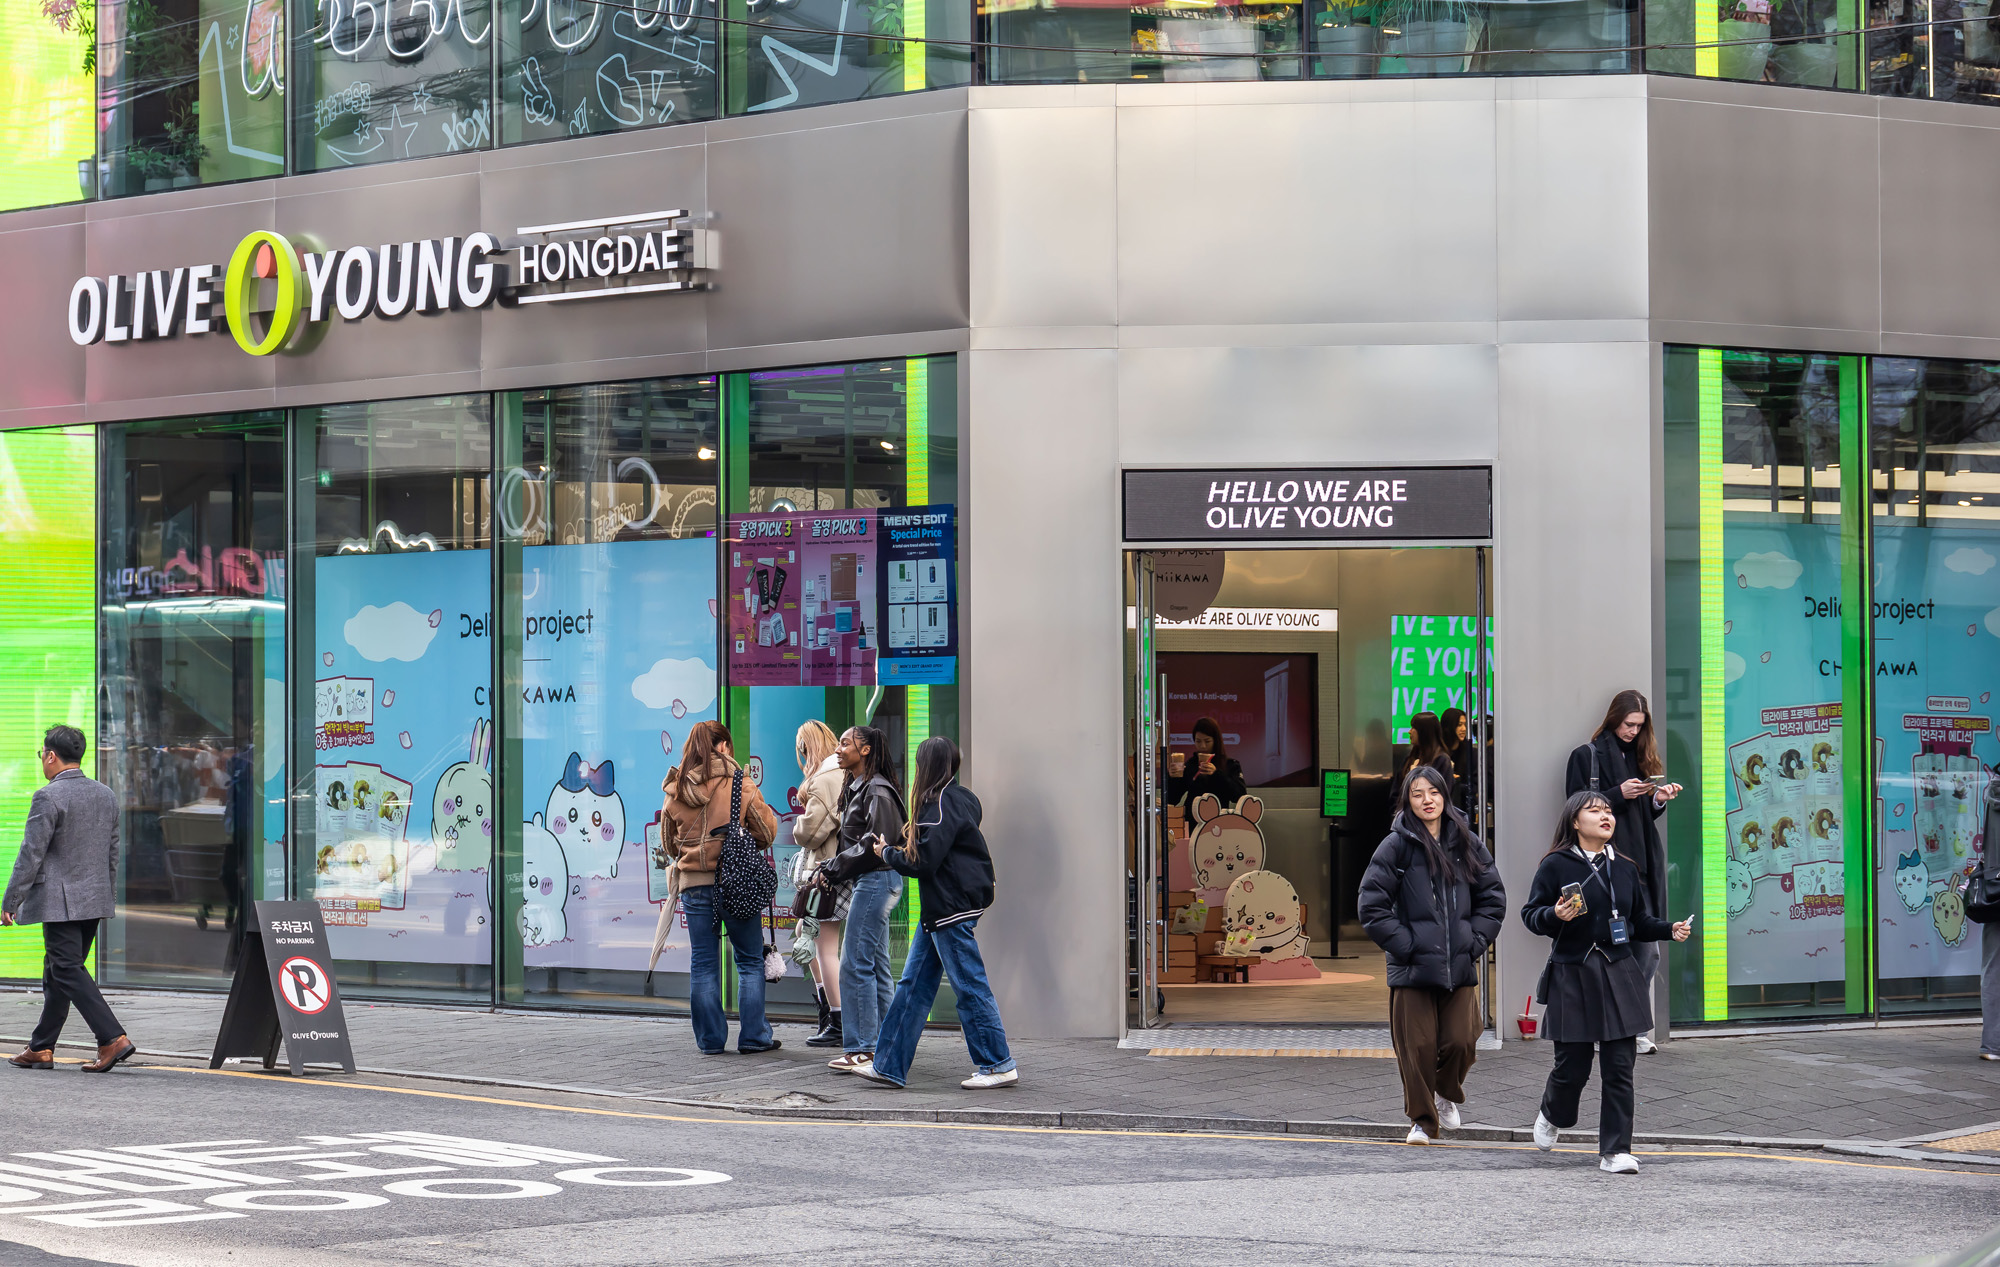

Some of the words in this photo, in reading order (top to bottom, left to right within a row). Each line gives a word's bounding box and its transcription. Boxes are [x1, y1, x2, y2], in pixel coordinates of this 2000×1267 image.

[519, 228, 680, 285] HONGDAE
[68, 264, 216, 346] OLIVE
[303, 231, 498, 322] YOUNG
[1207, 480, 1299, 503] HELLO
[1304, 480, 1350, 502] WE
[1352, 480, 1408, 502] ARE
[884, 514, 921, 526] MEN'S
[922, 514, 947, 525] EDIT
[1206, 506, 1288, 529] OLIVE
[1294, 505, 1394, 528] YOUNG
[739, 520, 756, 539] 올영
[758, 521, 782, 537] PICK
[784, 520, 792, 537] 3
[812, 519, 830, 538] 올영
[832, 519, 856, 536] PICK
[858, 518, 867, 536] 3
[890, 528, 920, 542] Special
[922, 526, 942, 538] Price
[1874, 598, 1934, 625] project
[526, 608, 594, 642] project
[1209, 612, 1234, 625] ARE
[1236, 612, 1274, 626] OLIVE
[1276, 613, 1320, 627] YOUNG
[1204, 692, 1238, 701] Anti-aging
[1762, 710, 1789, 722] 딜라이트
[1790, 708, 1816, 720] 프로젝트
[1904, 717, 1928, 728] 딜라이트
[1930, 718, 1953, 728] 프로젝트
[1780, 722, 1803, 735] 먼작귀
[1804, 718, 1829, 732] 에디션
[1921, 730, 1946, 742] 먼작귀
[1948, 730, 1972, 742] 에디션
[334, 900, 357, 910] 프로젝트
[1790, 905, 1806, 919] 10종
[324, 911, 345, 924] 먼작귀
[346, 912, 367, 925] 에디션
[271, 920, 314, 934] 주차금지
